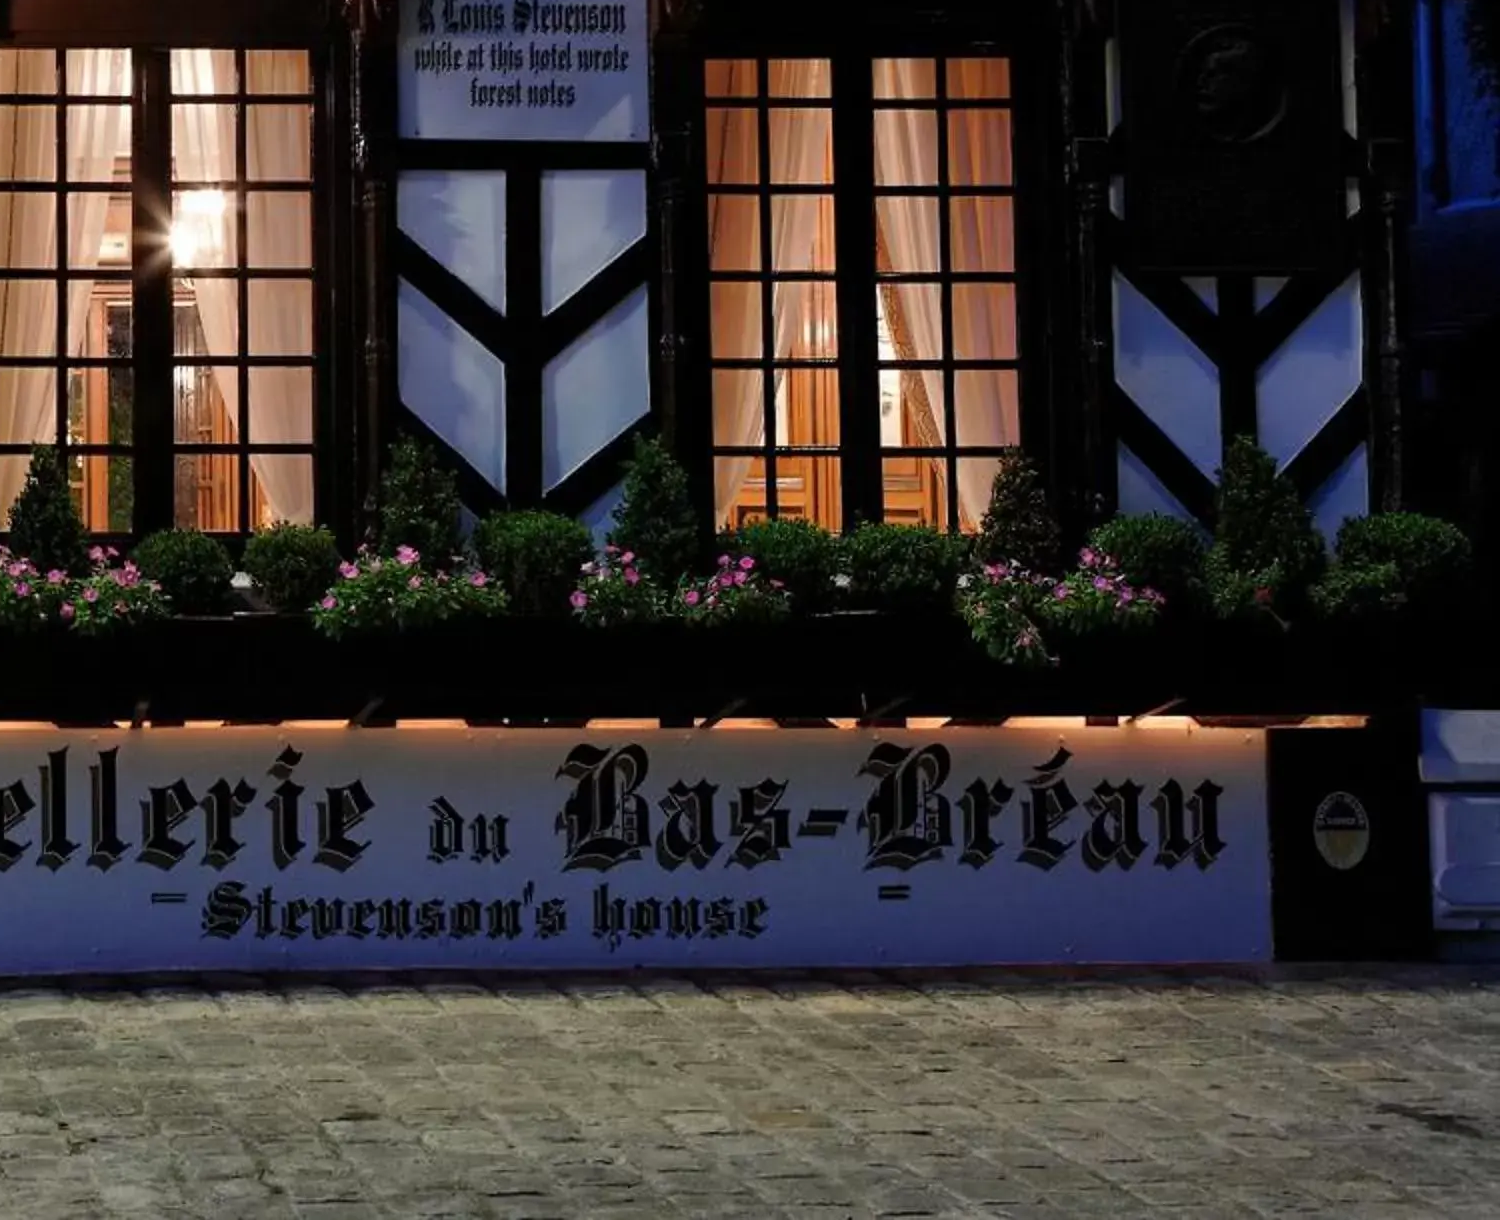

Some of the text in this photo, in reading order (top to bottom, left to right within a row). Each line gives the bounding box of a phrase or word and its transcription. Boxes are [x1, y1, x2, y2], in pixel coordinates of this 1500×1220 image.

[414, 40, 630, 76] while at this hotel wrote
[469, 77, 576, 108] forest notes
[428, 796, 509, 864] du
[555, 742, 1228, 872] Bas-Bréau
[202, 879, 771, 954] Stevenson's house
